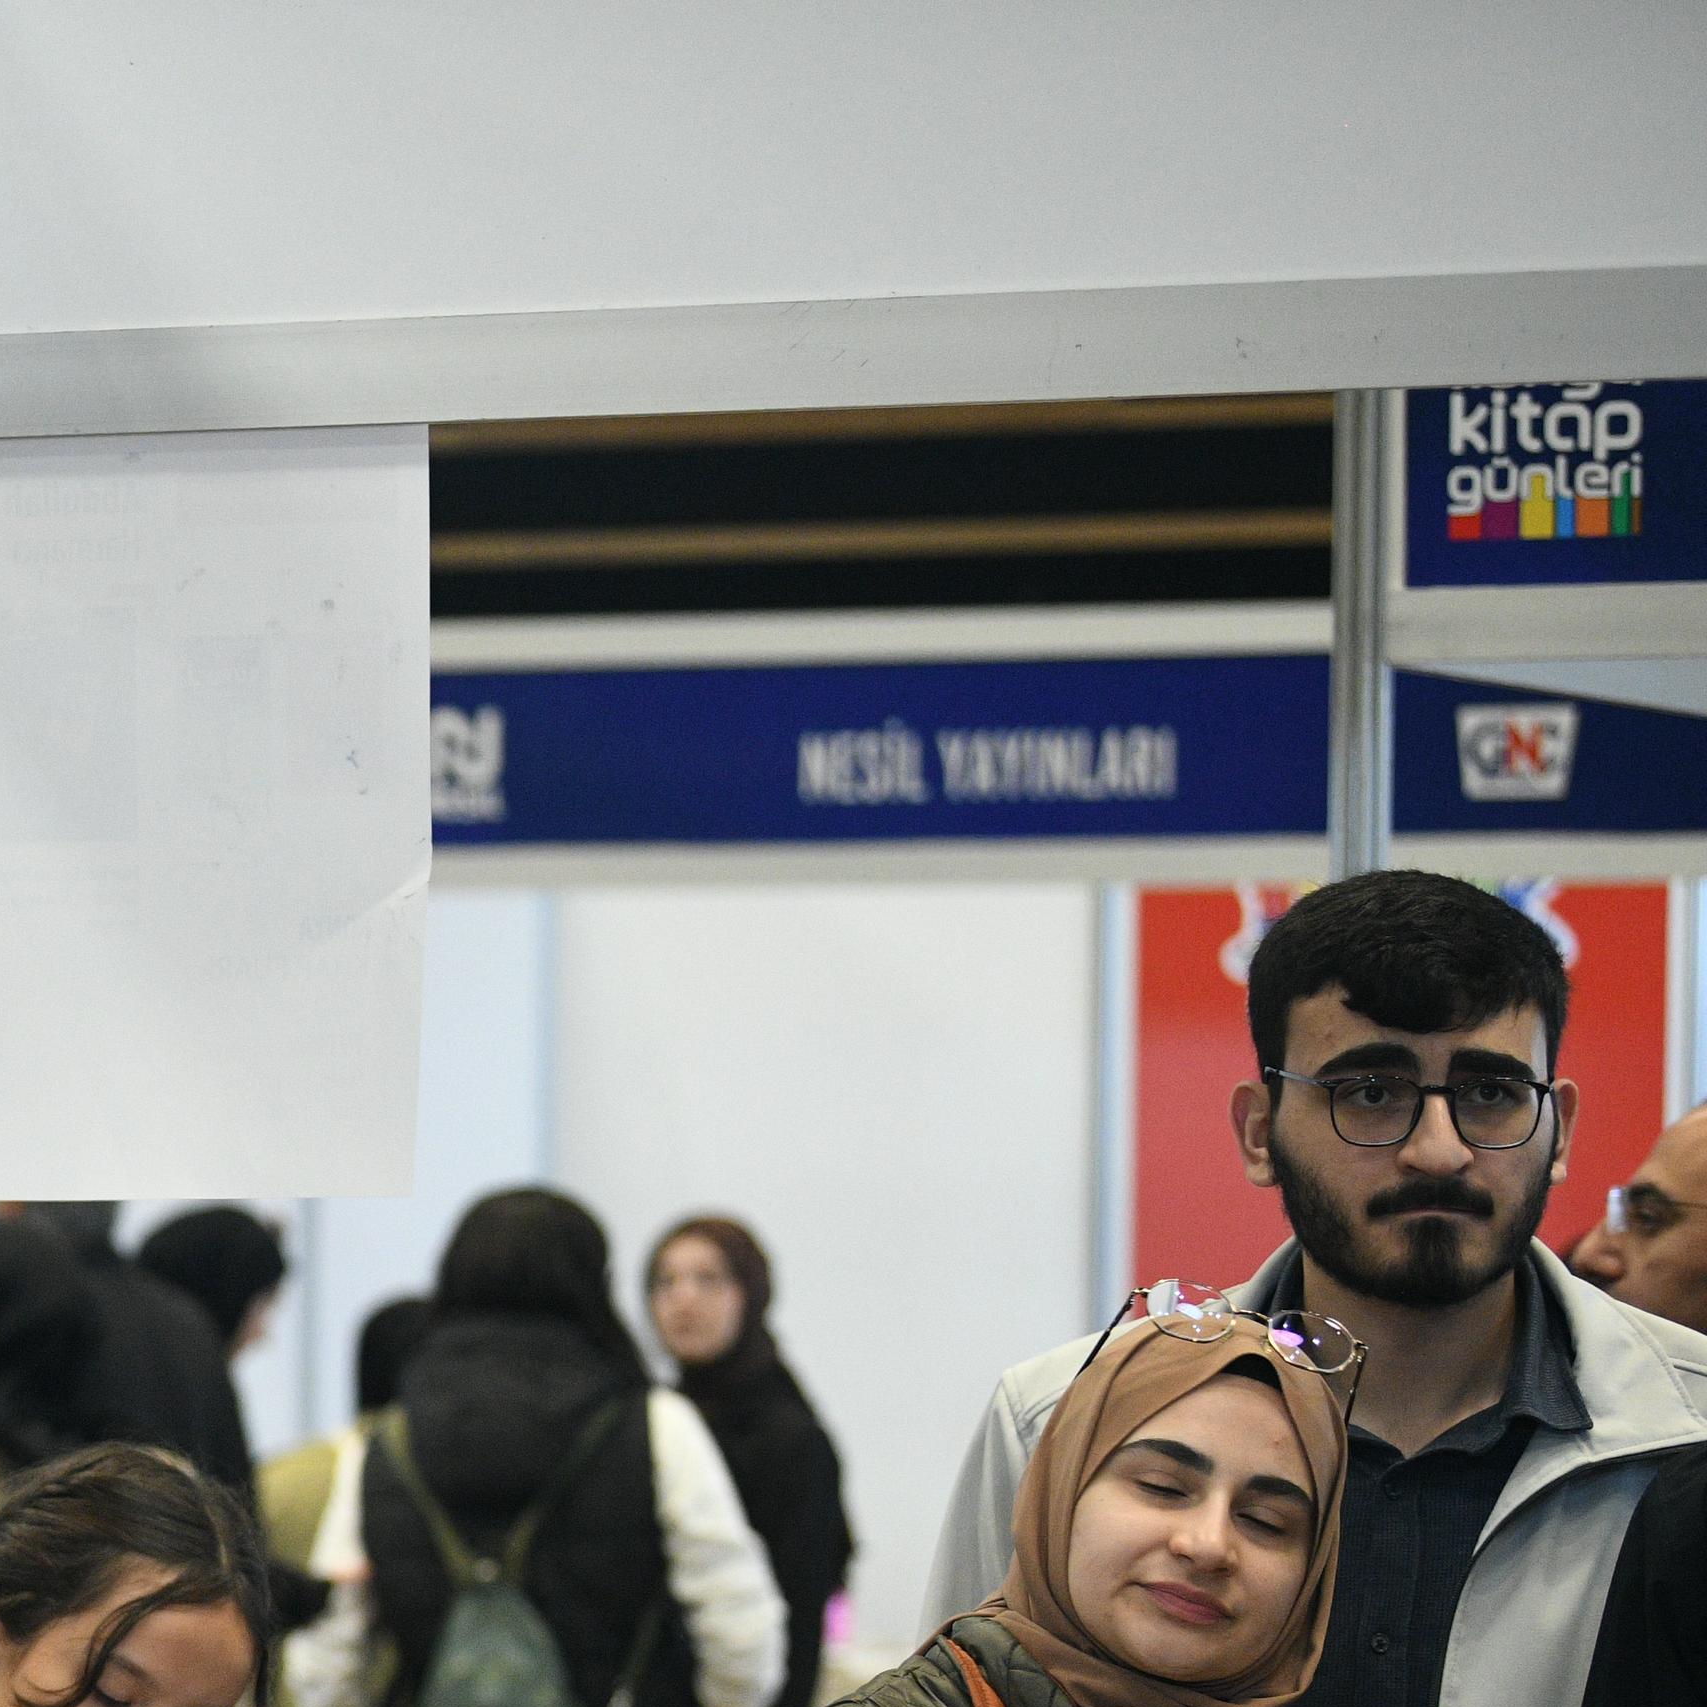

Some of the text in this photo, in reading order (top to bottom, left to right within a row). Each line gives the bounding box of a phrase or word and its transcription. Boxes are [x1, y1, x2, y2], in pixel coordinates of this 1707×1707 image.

[1448, 391, 1644, 460] kitap
[1447, 453, 1644, 517] günleri
[935, 724, 1177, 802] YAYINLARI
